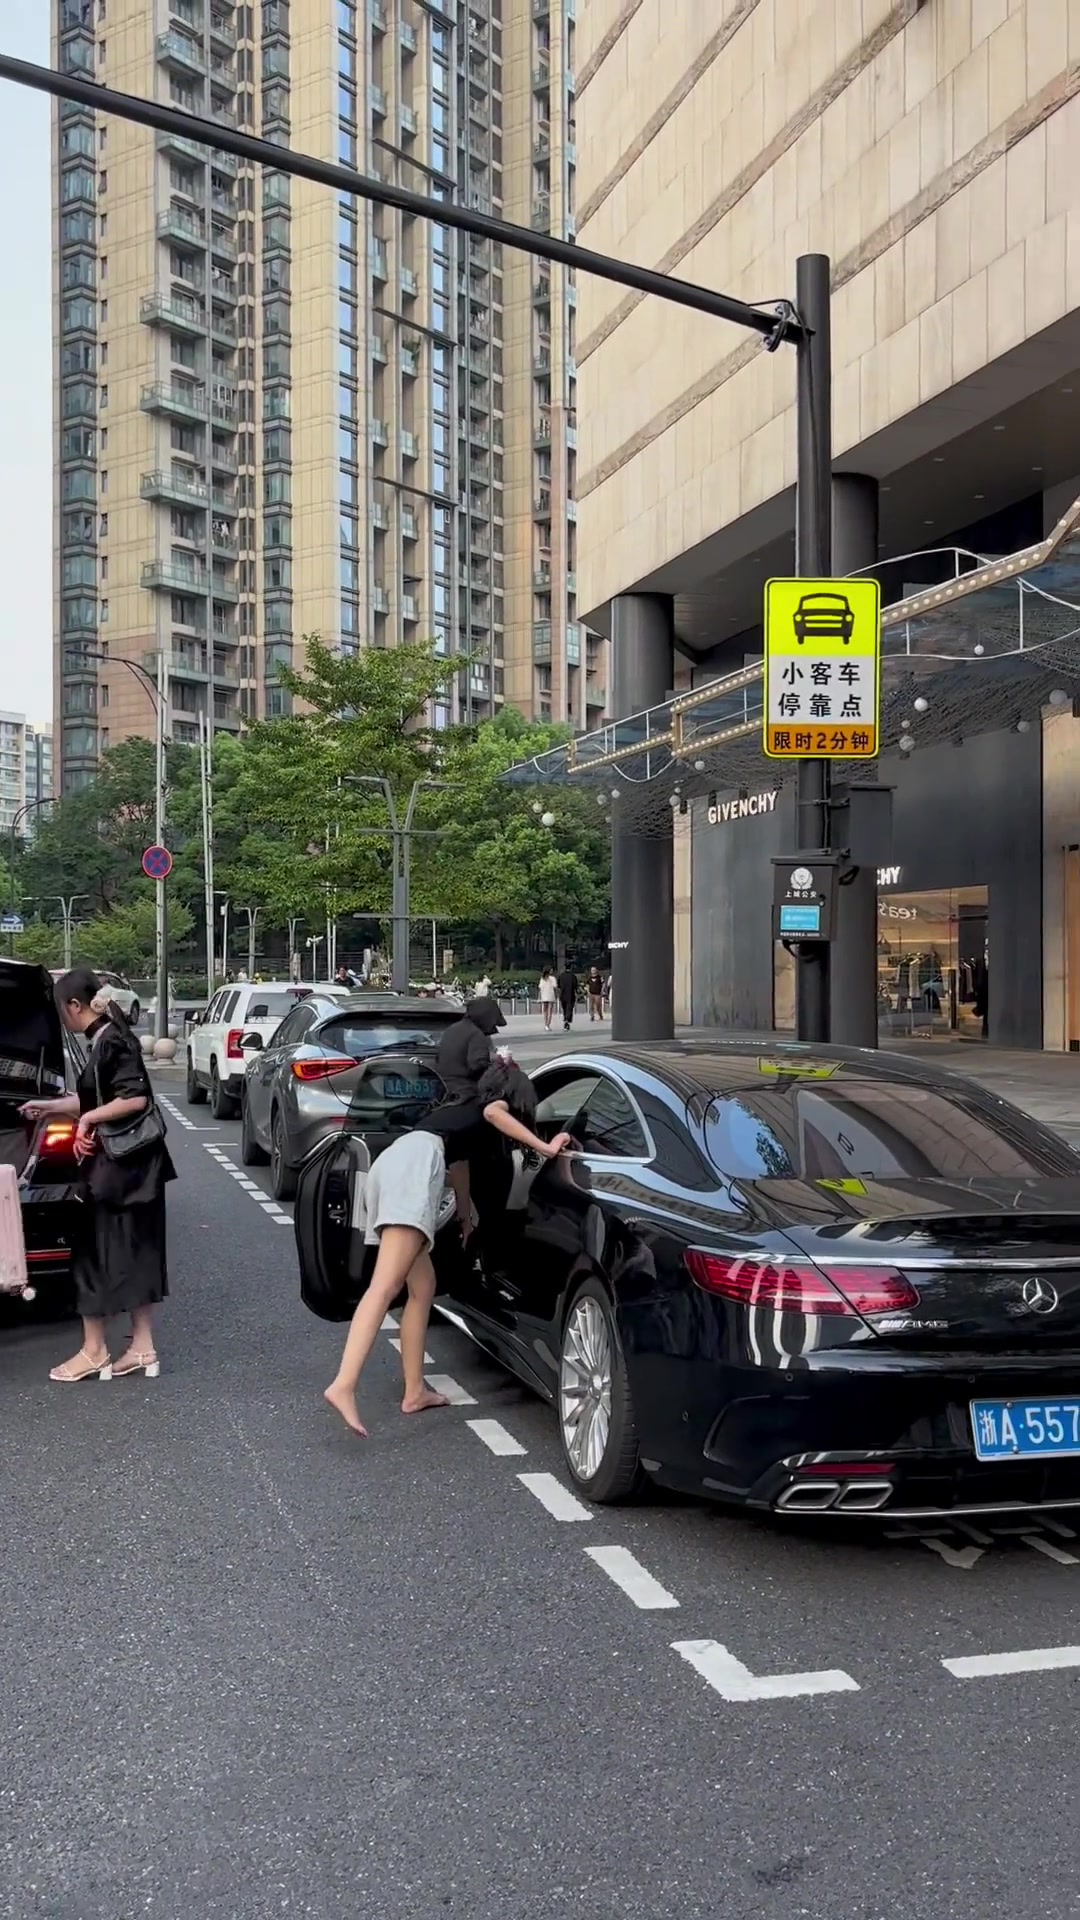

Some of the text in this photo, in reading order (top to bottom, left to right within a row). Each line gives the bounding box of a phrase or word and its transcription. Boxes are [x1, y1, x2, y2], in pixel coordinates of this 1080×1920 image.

[782, 661, 860, 686] 小客车
[778, 692, 862, 718] 停靠点
[773, 731, 869, 750] 限时2分钟
[708, 791, 777, 825] GIVENCHY
